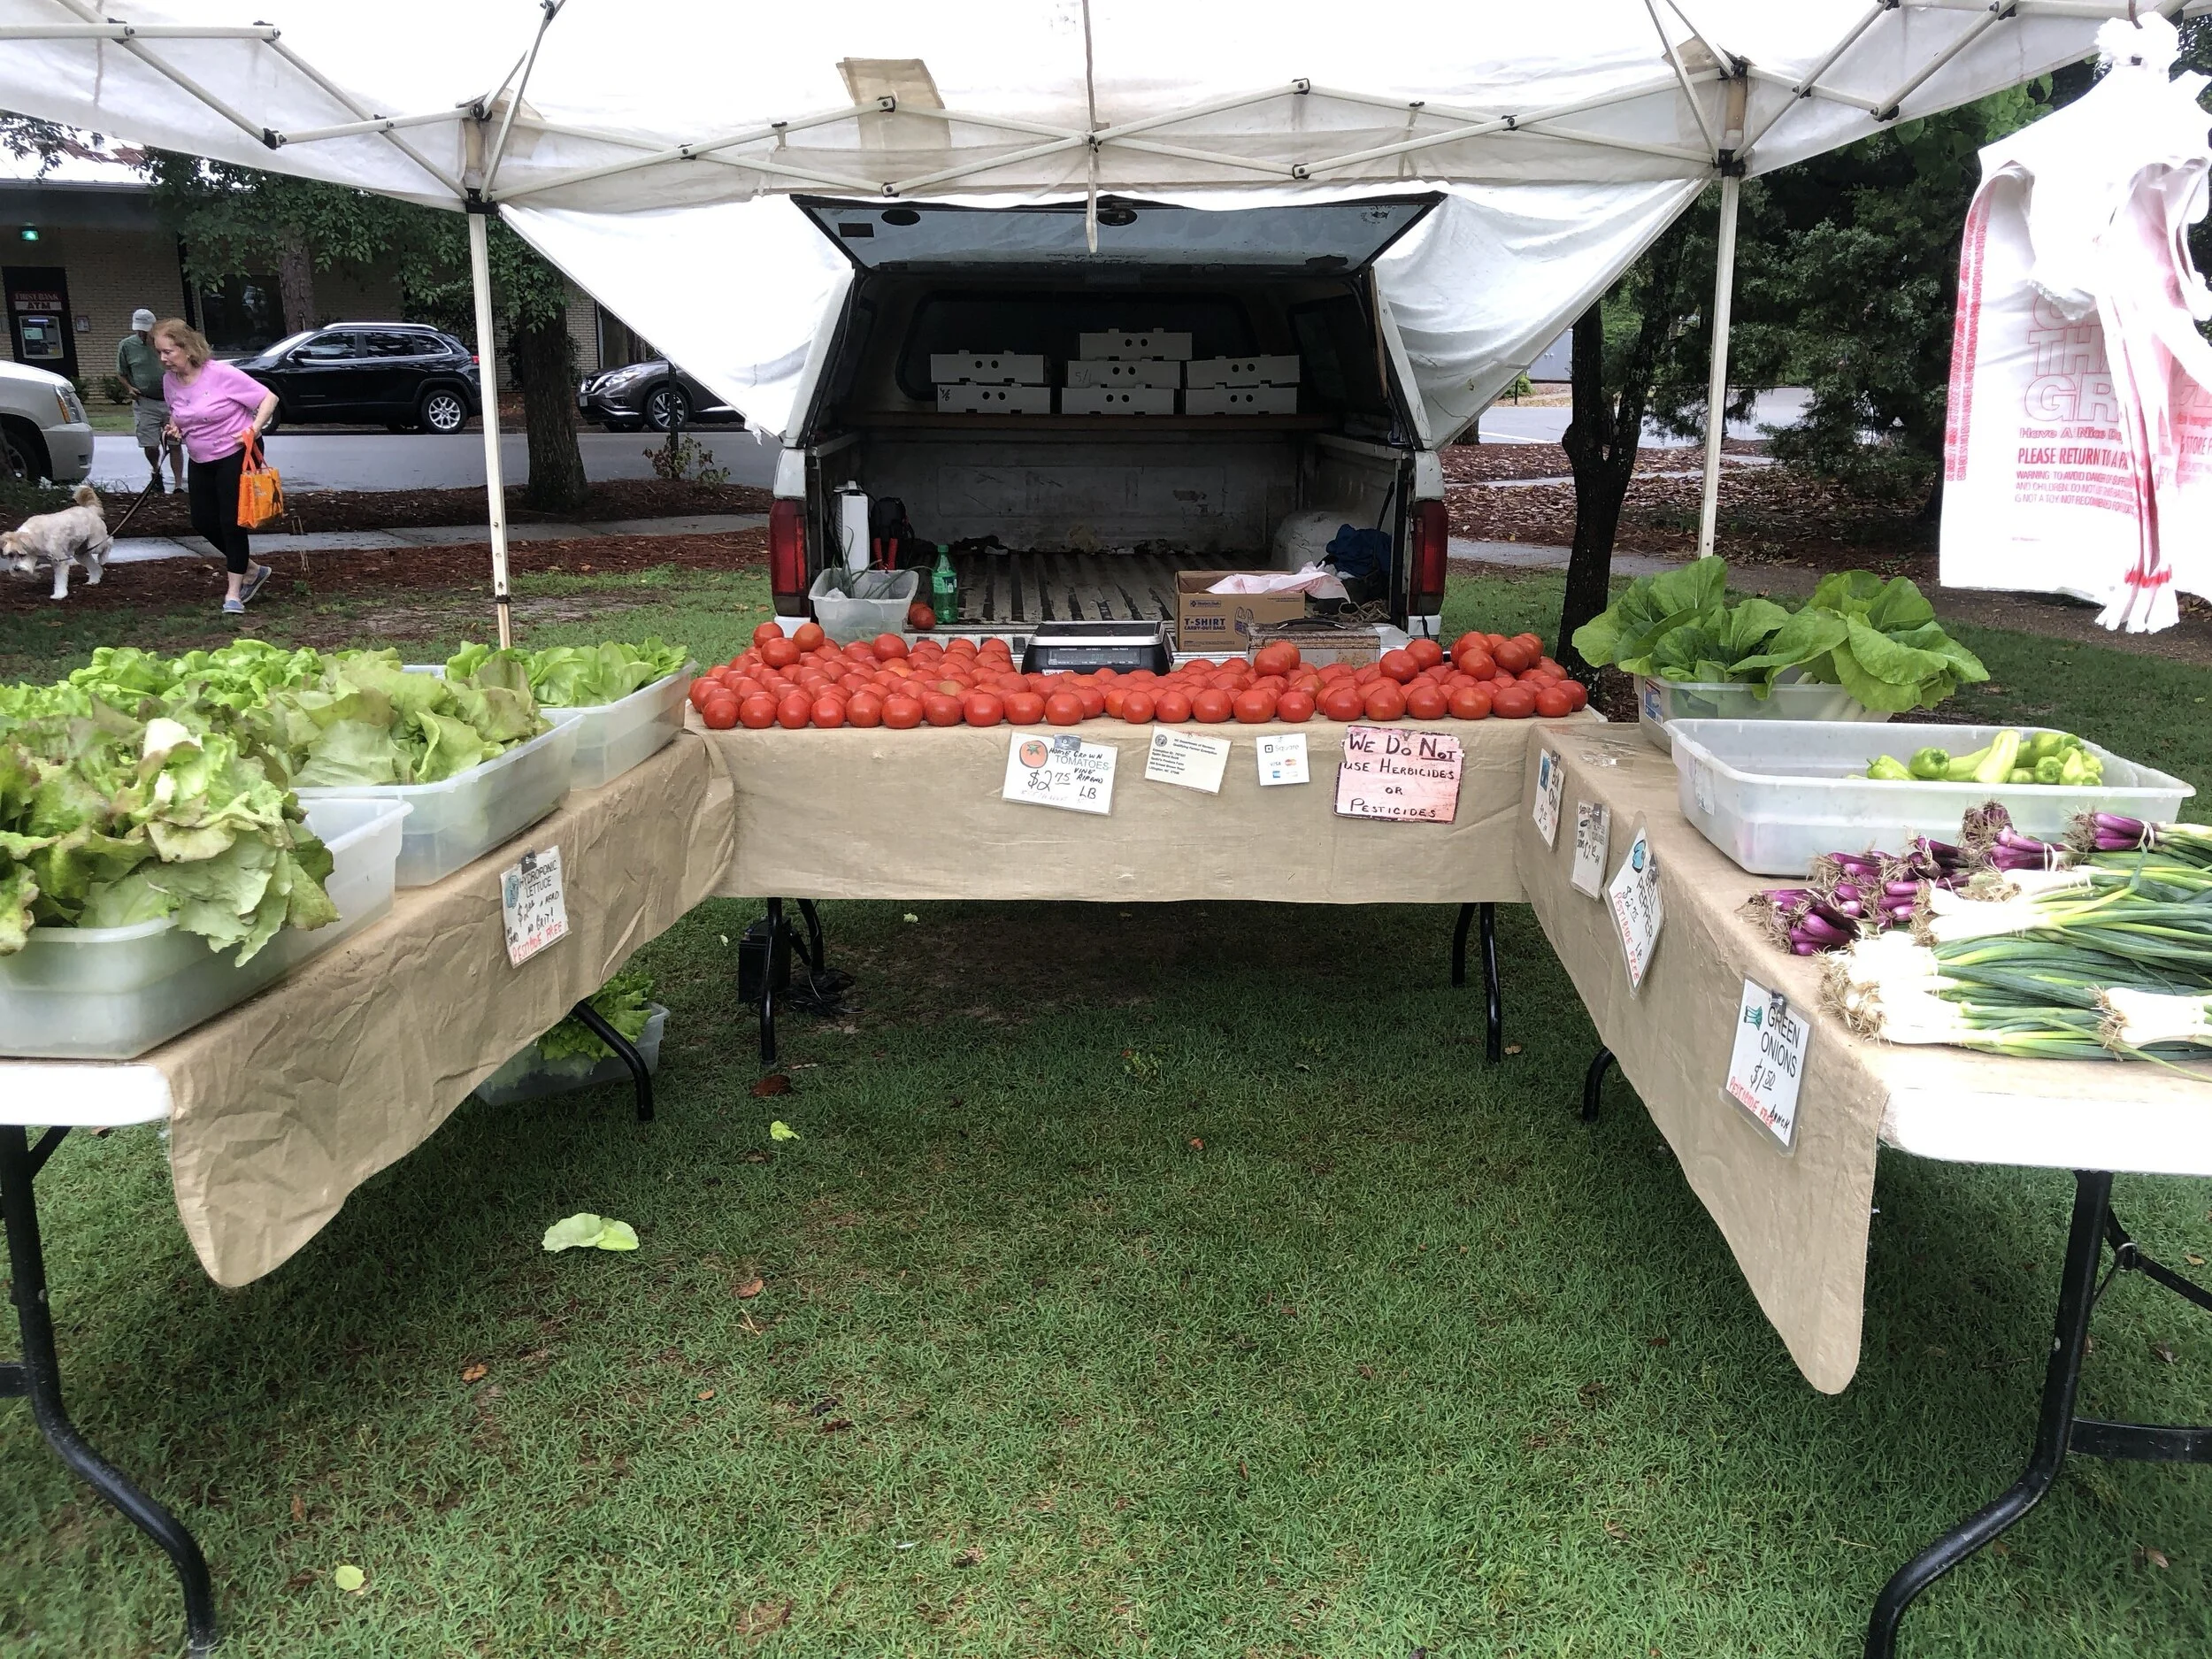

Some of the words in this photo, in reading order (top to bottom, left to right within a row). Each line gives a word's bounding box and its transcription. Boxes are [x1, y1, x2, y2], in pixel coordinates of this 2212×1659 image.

[2024, 373, 2119, 422] GR
[2020, 427, 2057, 439] Have
[2061, 427, 2072, 439] A
[2078, 426, 2107, 440] Nice
[2108, 428, 2123, 441] Da
[2186, 435, 2208, 456] STORE
[2017, 448, 2055, 465] PLEASE
[2059, 448, 2101, 465] RETURN
[2101, 449, 2111, 466] TO
[2111, 450, 2118, 468] A
[2054, 471, 2062, 480] TO
[2064, 471, 2085, 481] AVOID
[2016, 482, 2031, 491] AND
[2070, 483, 2081, 493] DO
[2082, 484, 2095, 494] NOT
[2023, 494, 2037, 503] NOT
[2039, 494, 2045, 503] A
[2062, 495, 2075, 505] NOT
[1049, 748, 1071, 757] HOME
[1349, 733, 1376, 753] WE
[1056, 755, 1110, 771] TOMATOES
[1344, 762, 1371, 772] USE
[1380, 758, 1455, 780] HERBICIDES
[1079, 786, 1097, 800] LB
[1385, 787, 1403, 795] OR
[1350, 798, 1437, 818] PESTICIDES
[519, 860, 557, 888] HYDROPONIC
[526, 876, 552, 899] LETTUCE
[545, 890, 560, 904] HEAD
[1637, 875, 1653, 945] PEPPER
[545, 921, 562, 941] FREE
[1614, 892, 1633, 944] PESTICIDE
[1629, 951, 1640, 980] FREE
[1767, 1006, 1801, 1049] GREEN
[1761, 1031, 1797, 1078] ONIONS
[1729, 1076, 1760, 1112] PESTICIDE
[1760, 1105, 1776, 1129] FREE
